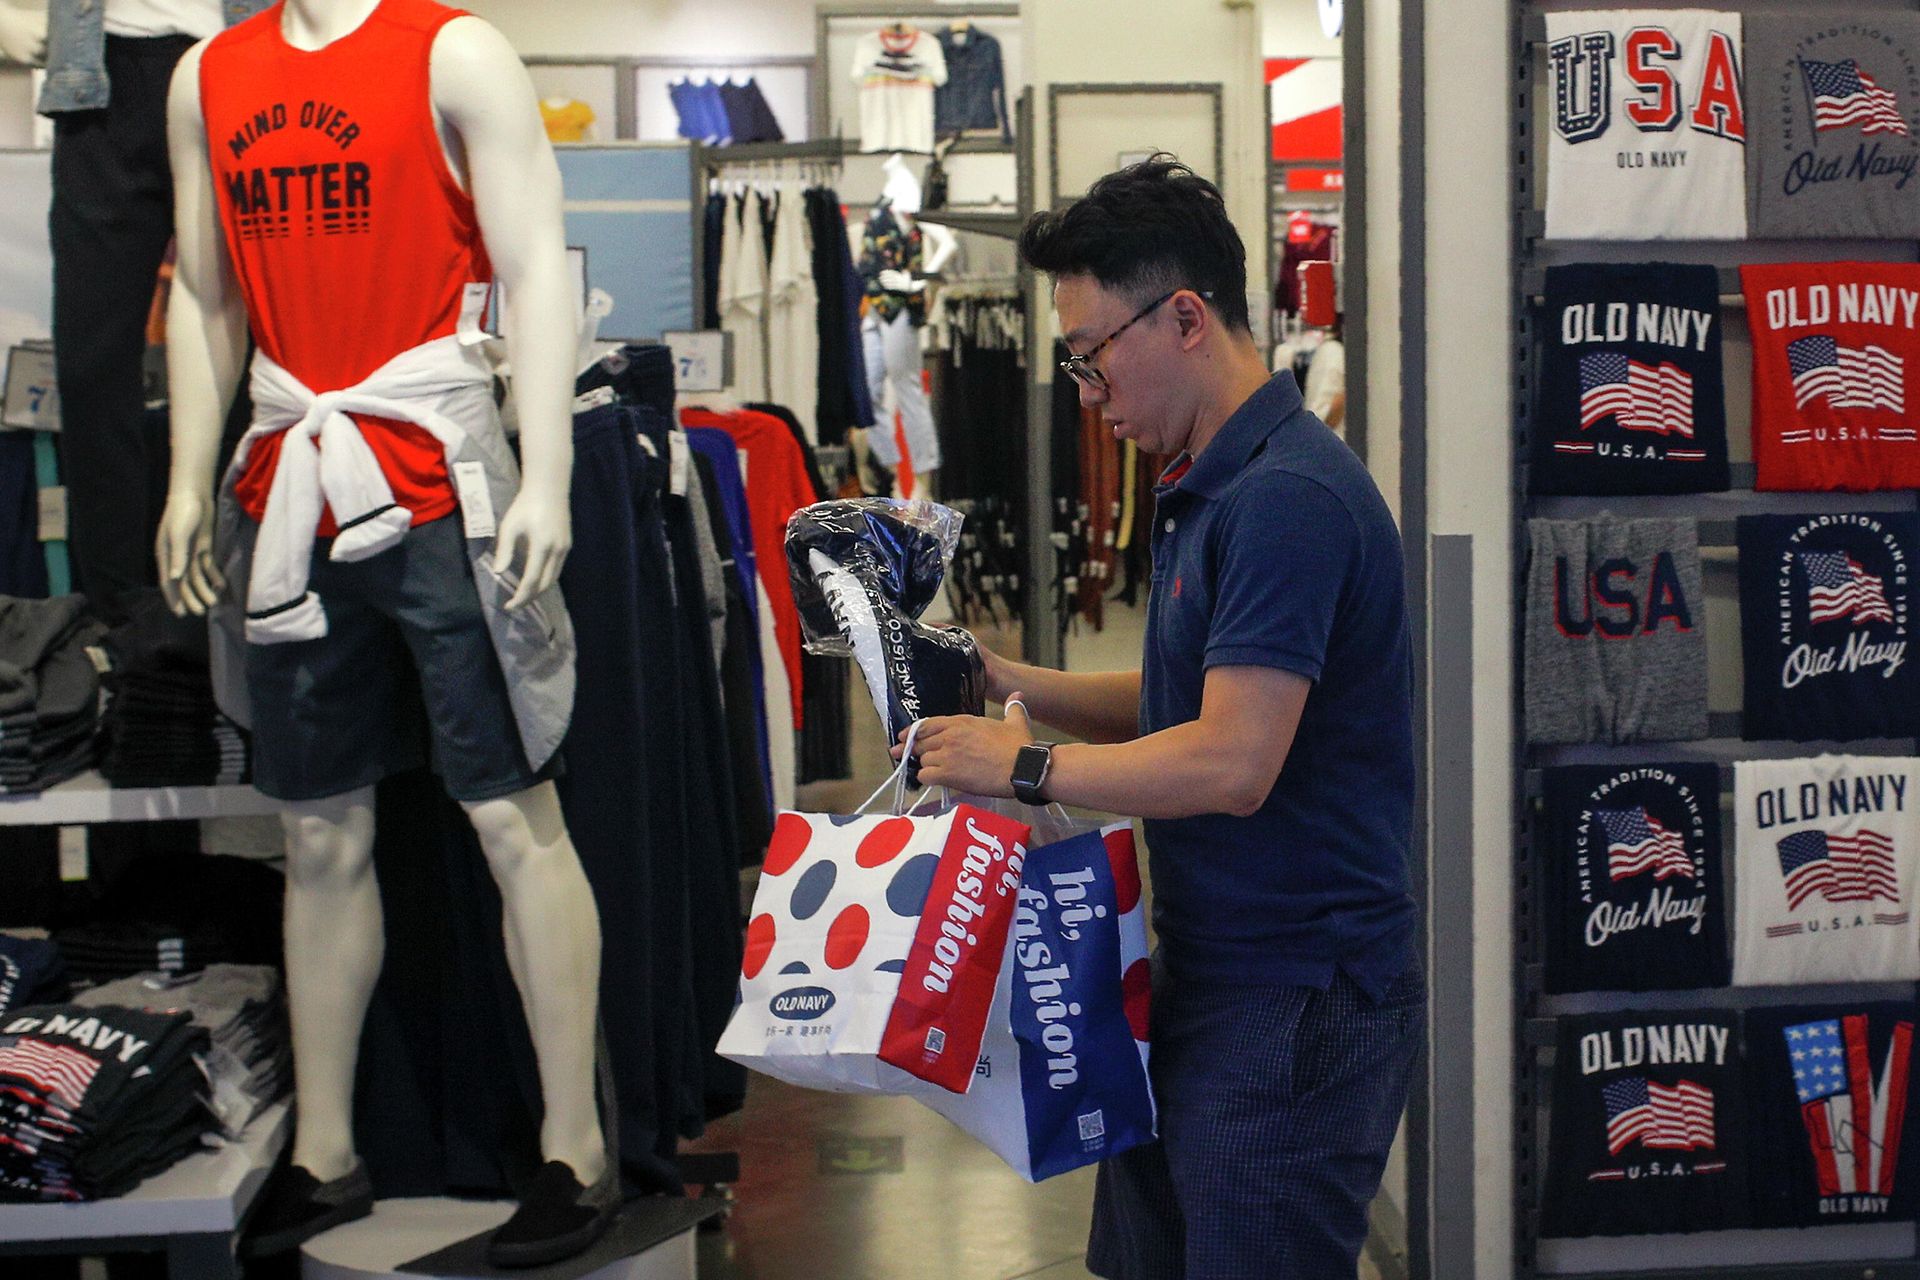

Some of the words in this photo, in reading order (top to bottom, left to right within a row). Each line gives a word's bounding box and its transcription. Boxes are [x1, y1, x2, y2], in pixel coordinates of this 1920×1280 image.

[1548, 25, 1745, 145] USA
[228, 103, 287, 160] MIND
[300, 101, 360, 150] OVER
[1617, 152, 1643, 168] OLD
[1651, 151, 1687, 167] NAVY
[1784, 152, 1843, 195] Old
[1847, 143, 1919, 190] Navy
[225, 162, 370, 216] MATTER
[1562, 303, 1629, 344] OLD
[1636, 303, 1711, 351] NAVY
[1767, 284, 1830, 330] OLD
[1838, 283, 1918, 329] NAVY
[1598, 443, 1664, 460] U.S.A.
[1815, 427, 1878, 441] U.S.A.
[1554, 551, 1693, 640] USA
[1779, 552, 1794, 645] AMERICAN
[1790, 514, 1882, 543] TRADITION
[1883, 534, 1907, 584] SINCE
[1782, 643, 1836, 688] Old
[1838, 631, 1907, 678] Navy
[1757, 782, 1819, 829] OLD
[1829, 775, 1906, 816] NAVY
[1577, 810, 1593, 903] AMERICAN
[1591, 769, 1676, 800] TRADITION
[1678, 786, 1704, 837] SINCE
[922, 817, 1004, 994] fashion
[1049, 867, 1106, 940] hi,
[1585, 901, 1639, 946] Old
[1641, 886, 1706, 935] Navy
[1016, 884, 1081, 1090] fashion
[40, 1014, 149, 1062] NAVY
[1581, 1028, 1644, 1075] OLD
[1647, 1024, 1728, 1065] NAVY
[1628, 1162, 1691, 1179] U.S.A.
[1819, 1198, 1848, 1213] OLD
[1853, 1198, 1888, 1213] NAVY
